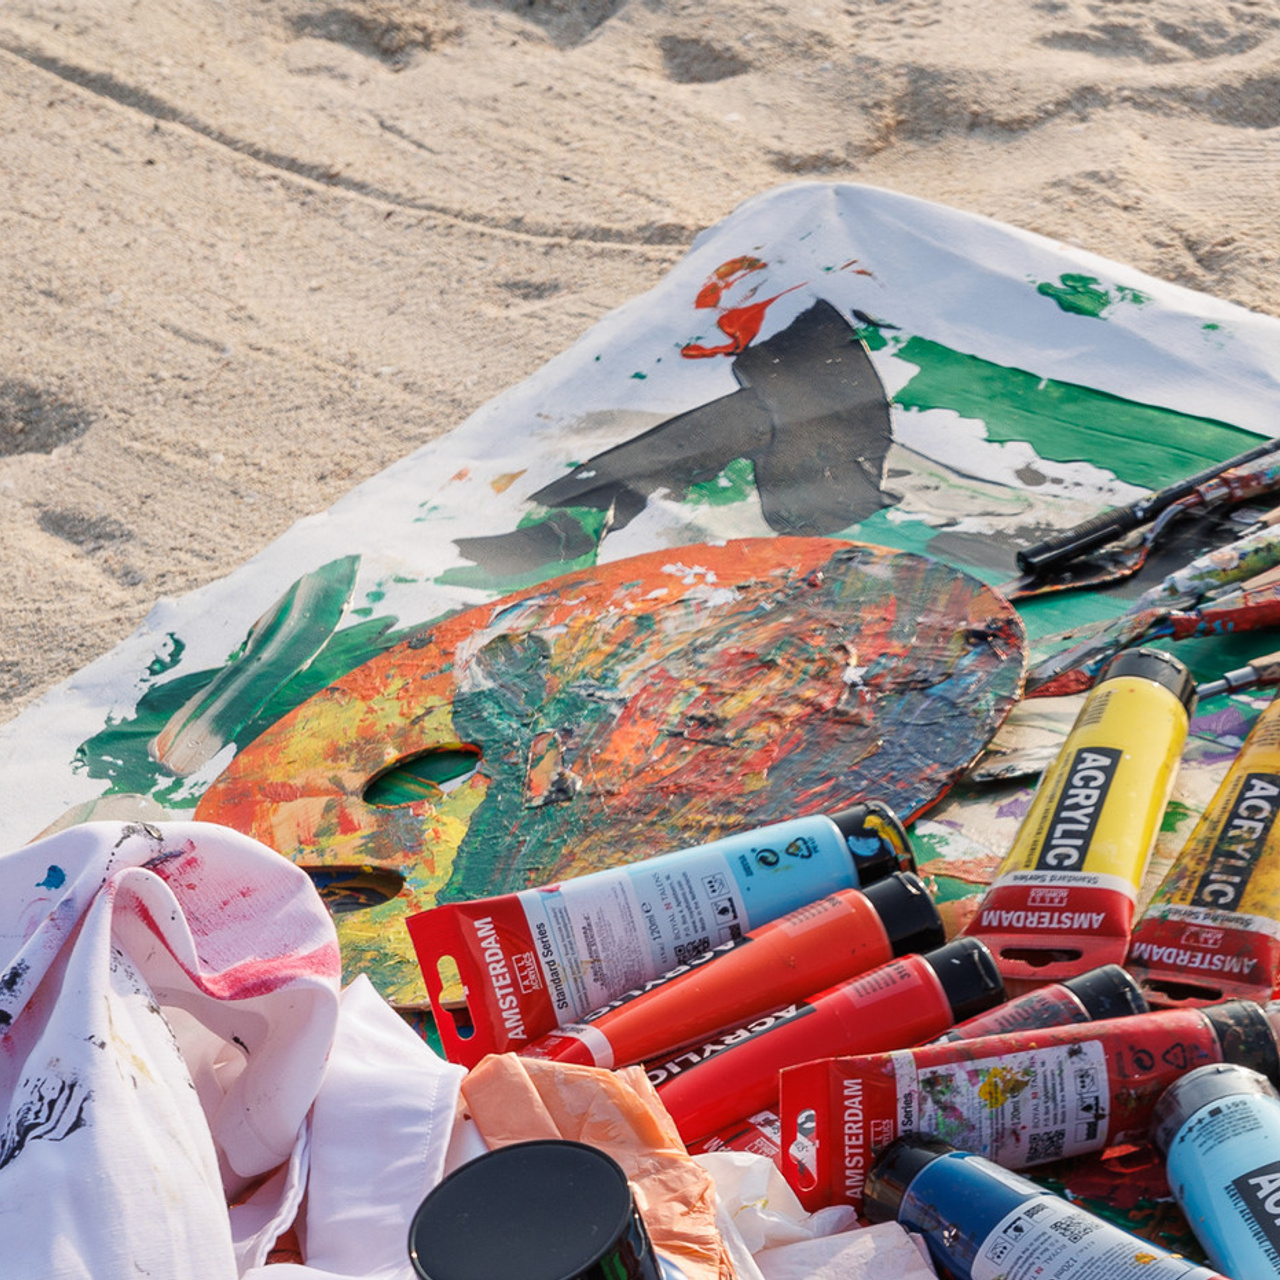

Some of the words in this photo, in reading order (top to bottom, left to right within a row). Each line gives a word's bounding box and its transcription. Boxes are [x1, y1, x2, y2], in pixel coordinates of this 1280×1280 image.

[1046, 752, 1111, 867] ACRYLIC
[1203, 778, 1280, 905] ACRYLIC
[536, 923, 553, 958] Series
[982, 909, 1105, 930] AMSTERDAM
[474, 916, 529, 1040] AMSTERDAM
[546, 959, 569, 1010] Standard
[1133, 943, 1258, 975] AMSTERDAM
[648, 1003, 799, 1086] ACRYLIC
[844, 1077, 863, 1199] AMSTERDAM
[902, 1092, 914, 1127] Series
